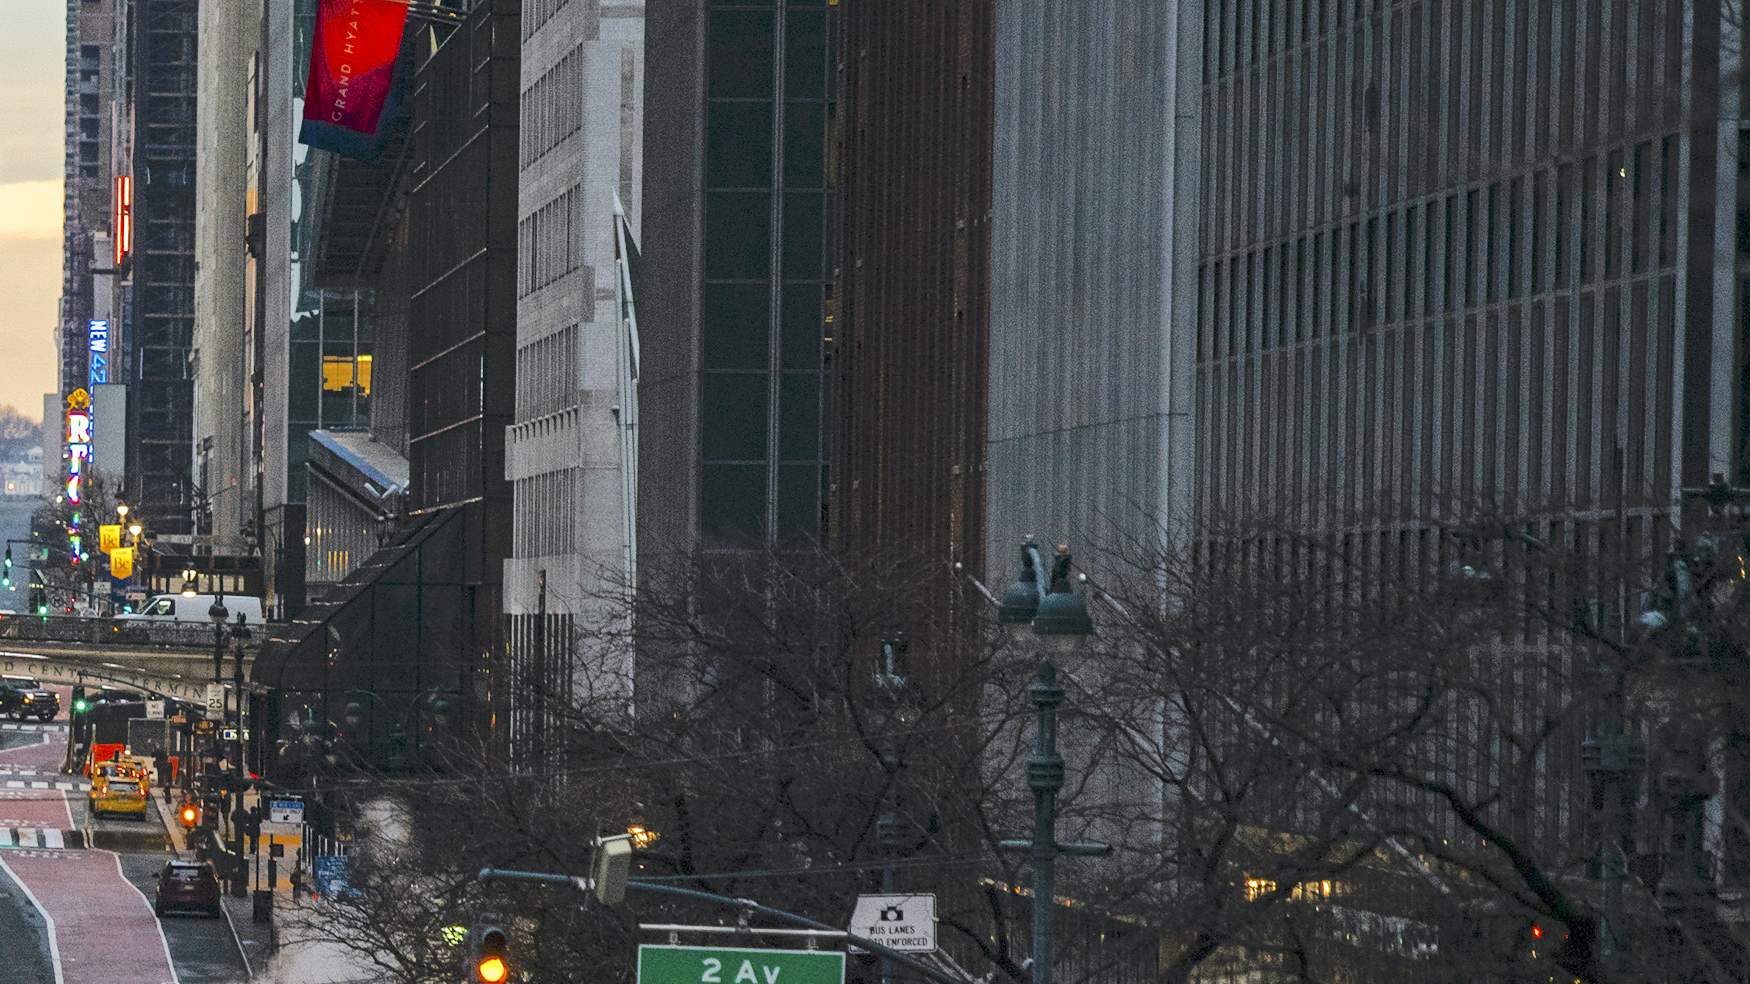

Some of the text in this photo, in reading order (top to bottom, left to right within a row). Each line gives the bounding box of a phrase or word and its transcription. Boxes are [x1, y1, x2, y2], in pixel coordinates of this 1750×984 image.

[331, 63, 352, 122] GRAND
[89, 319, 108, 352] NEW
[113, 557, 130, 570] Be
[130, 673, 204, 698] TERMIN
[208, 698, 223, 710] 25
[870, 925, 916, 935] BUS LANES
[886, 937, 928, 946] ENFORCED
[702, 957, 722, 984] 2
